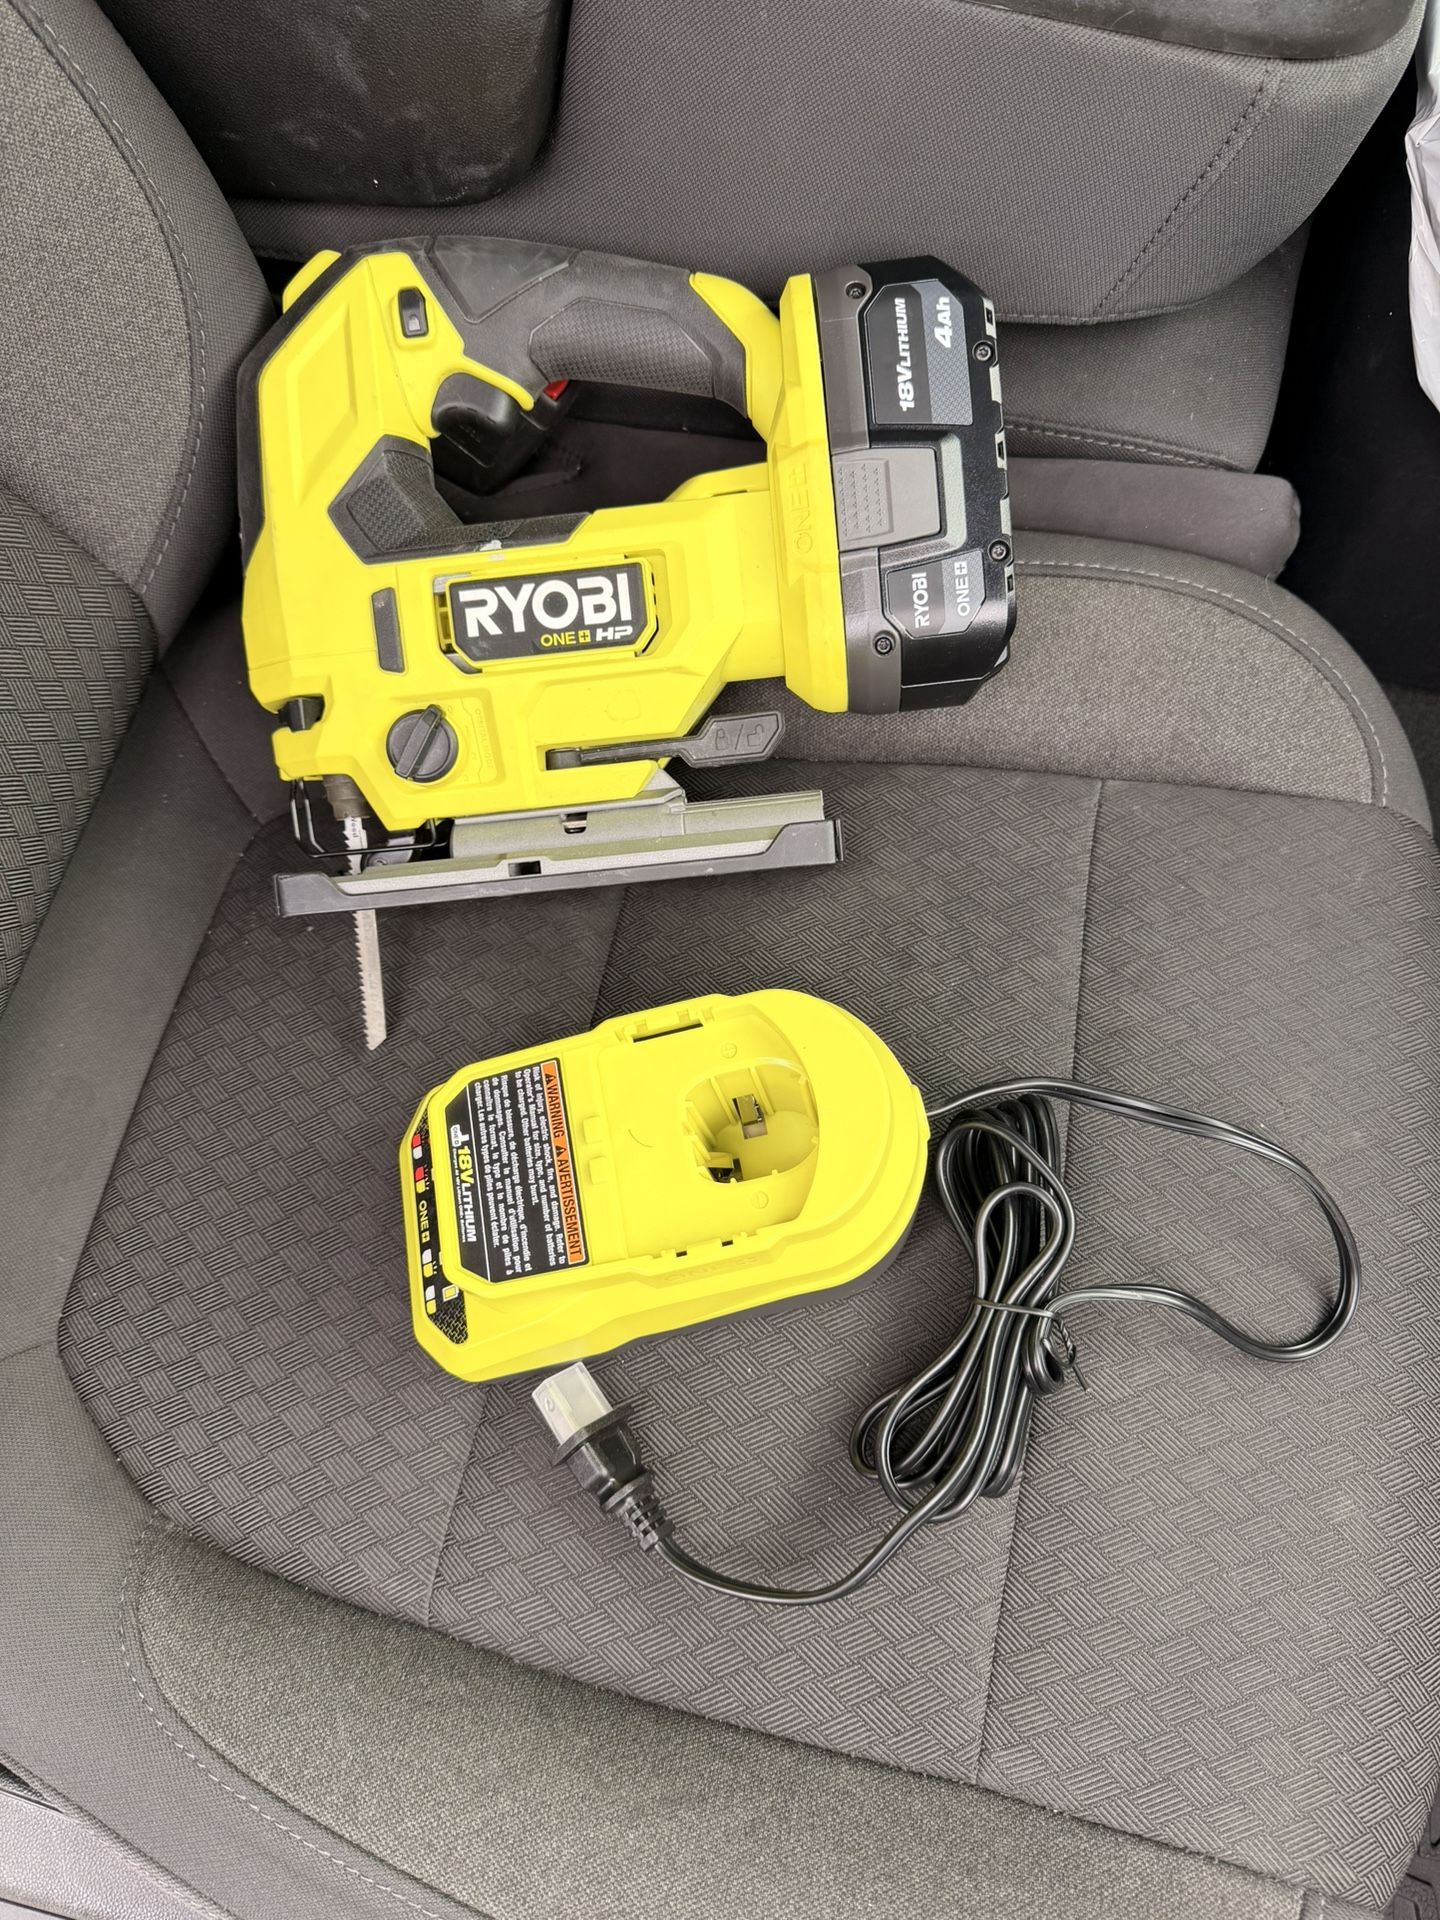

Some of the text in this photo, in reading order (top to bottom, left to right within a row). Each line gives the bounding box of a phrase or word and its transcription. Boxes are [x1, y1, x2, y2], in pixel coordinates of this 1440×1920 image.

[934, 296, 953, 348] 4Ah
[459, 573, 632, 638] RYOBI
[911, 572, 930, 628] RYOBI
[596, 625, 633, 642] HP
[546, 1083, 581, 1256] WARNING AVERTISSEMENT
